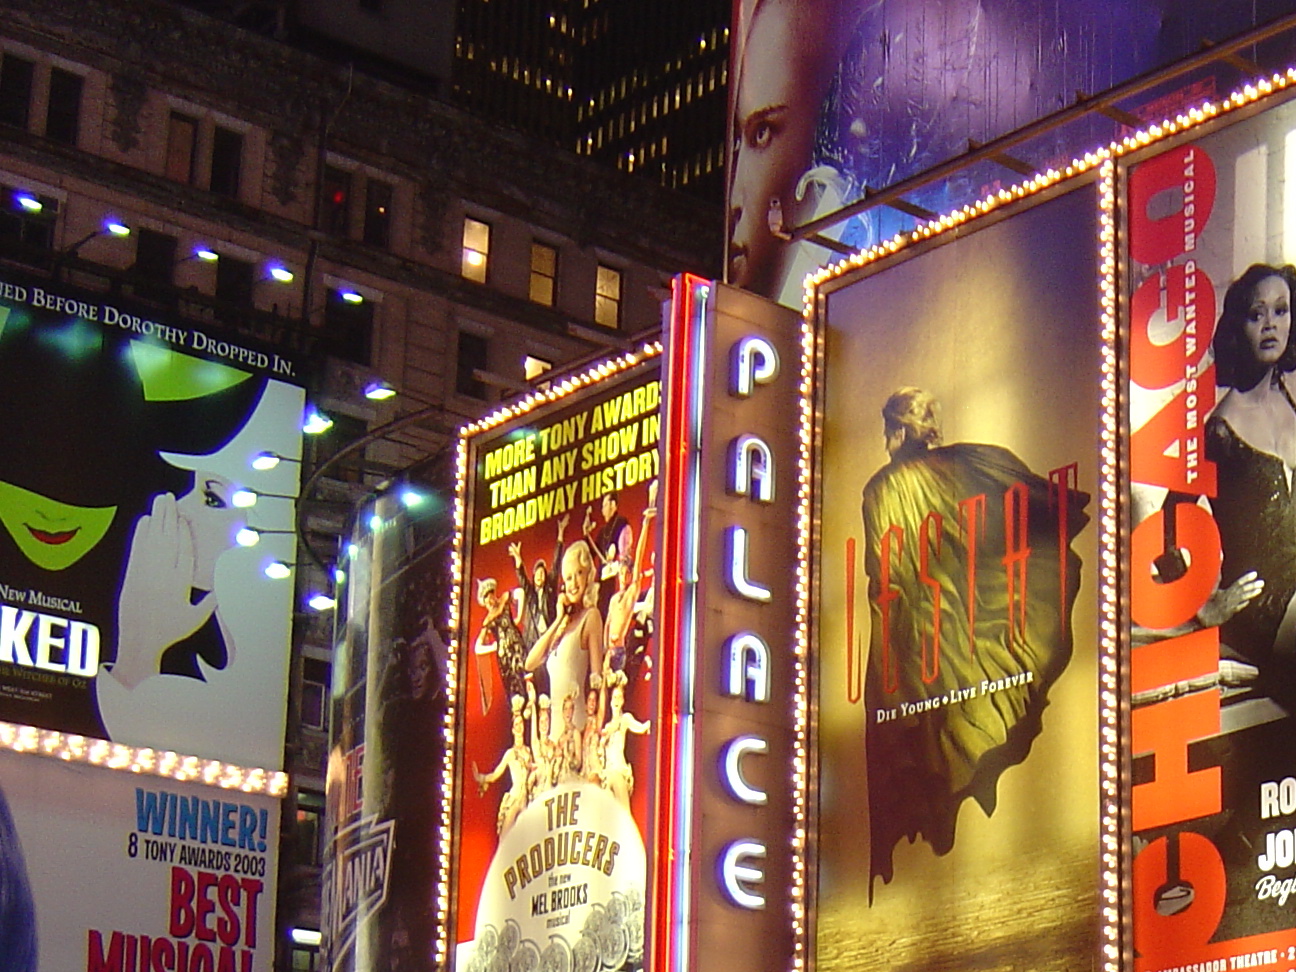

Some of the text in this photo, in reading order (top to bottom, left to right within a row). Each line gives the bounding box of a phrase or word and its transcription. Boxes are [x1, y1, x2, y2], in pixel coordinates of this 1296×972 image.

[1184, 150, 1198, 484] THE MOST WANTED MUSICAL
[484, 411, 588, 480] MORE TONY
[489, 465, 537, 509] THAN
[540, 447, 578, 488] ANY
[581, 421, 639, 470] SHOW
[479, 481, 579, 546] BROADWAY
[845, 461, 1081, 705] LESTAT
[1129, 144, 1226, 957] CHICAGO
[718, 336, 780, 911] PALACE
[135, 788, 268, 853] WINNER!
[545, 791, 581, 832] THE
[128, 832, 266, 877] 8 TONY AWARDS 2003
[503, 831, 620, 900] PRODUCERS
[170, 866, 263, 950] BEST
[531, 883, 588, 917] MEL BROOKS
[1230, 950, 1278, 972] THEATRE
